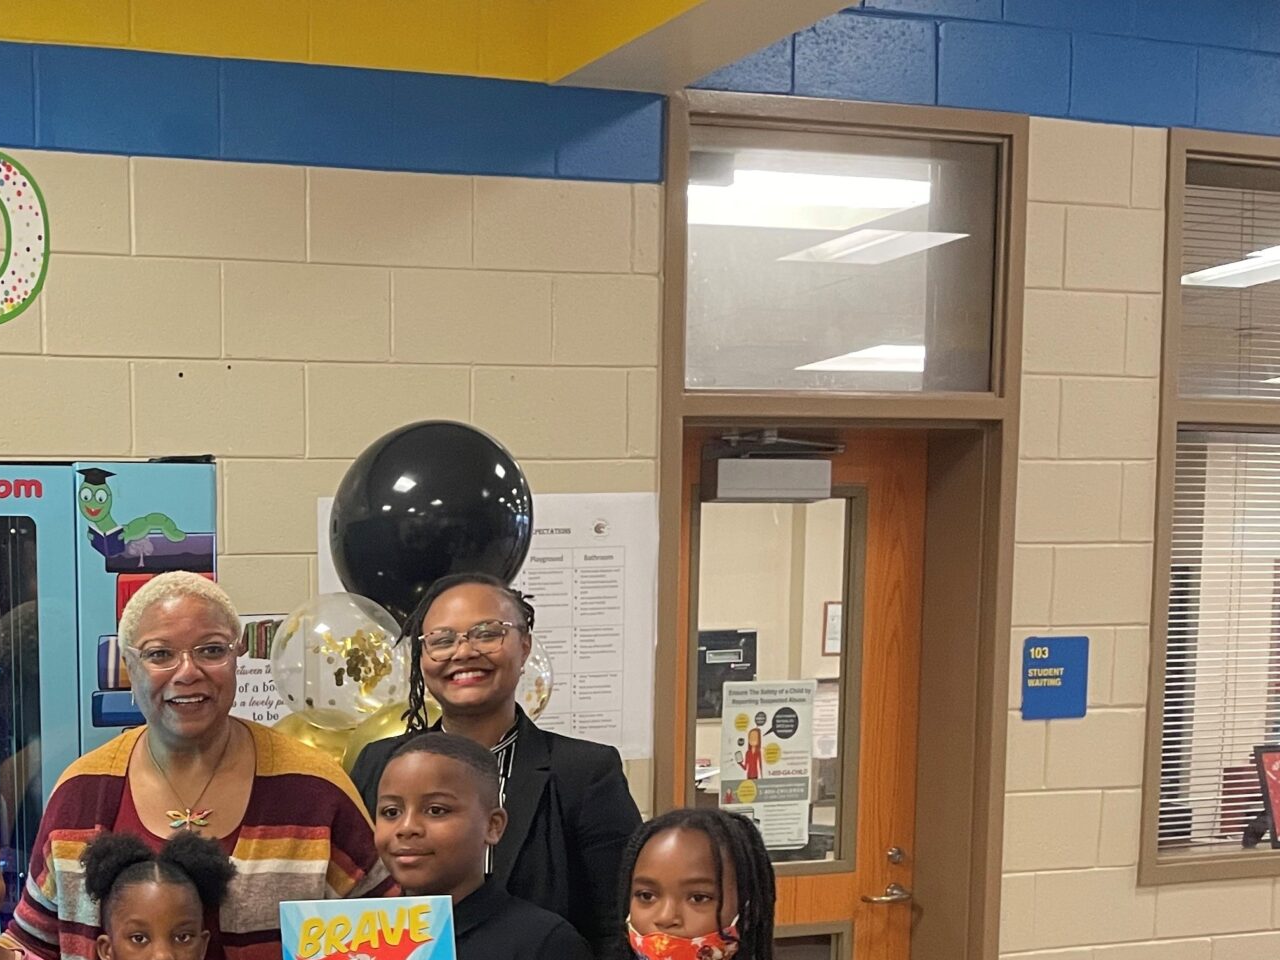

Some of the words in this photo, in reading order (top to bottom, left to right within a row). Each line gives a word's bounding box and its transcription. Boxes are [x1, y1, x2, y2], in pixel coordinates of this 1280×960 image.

[1029, 647, 1049, 659] 103
[235, 665, 263, 676] etween
[1028, 667, 1065, 677] STUDENT
[1027, 678, 1062, 687] WAITING
[239, 683, 249, 693] of
[248, 696, 274, 710] lovely
[252, 712, 263, 721] to
[297, 903, 435, 960] BRAVE
